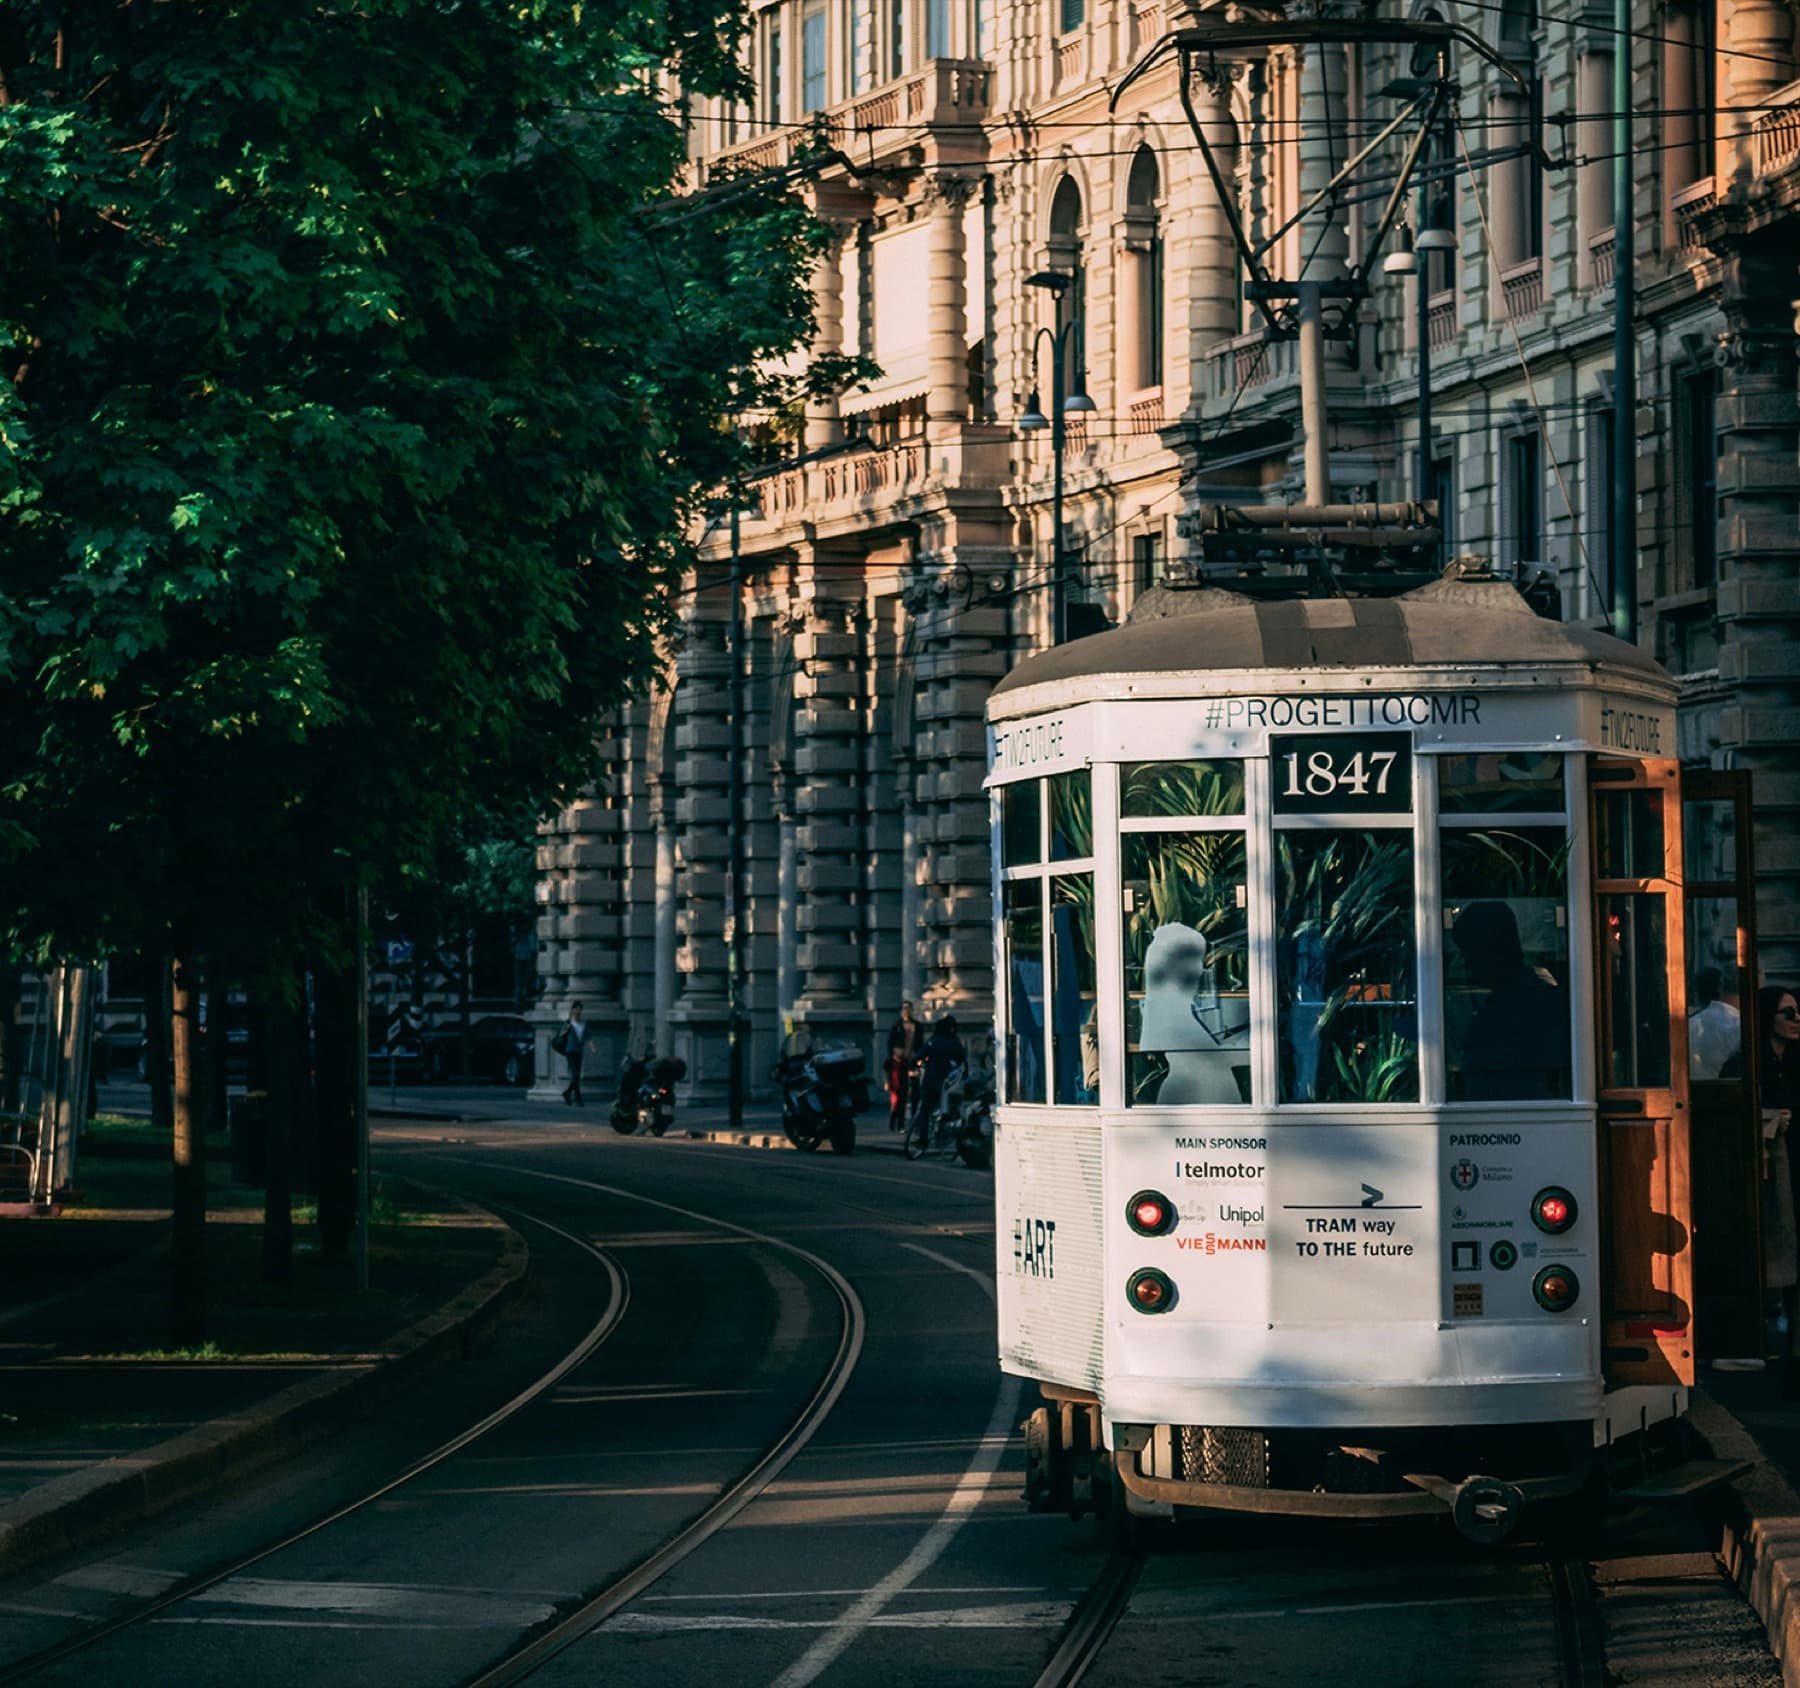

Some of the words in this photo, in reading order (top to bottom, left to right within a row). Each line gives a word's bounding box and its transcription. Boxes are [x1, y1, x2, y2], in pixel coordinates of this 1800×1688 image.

[1205, 696, 1480, 730] #PROGETTOCMR
[1282, 751, 1397, 796] 1847
[1175, 1138, 1207, 1150] MAIN
[1209, 1137, 1267, 1150] SPONSOR
[1450, 1133, 1521, 1146] PATROCINIO
[1184, 1161, 1265, 1178] telmotor
[1219, 1204, 1265, 1228] Unipol
[1306, 1218, 1356, 1233] TRAM
[1362, 1221, 1396, 1236] way
[1014, 1217, 1056, 1279] #ART
[1176, 1232, 1266, 1255] VIESSMANN
[1296, 1242, 1319, 1257] TO
[1323, 1242, 1357, 1257] THE
[1362, 1241, 1414, 1256] future
